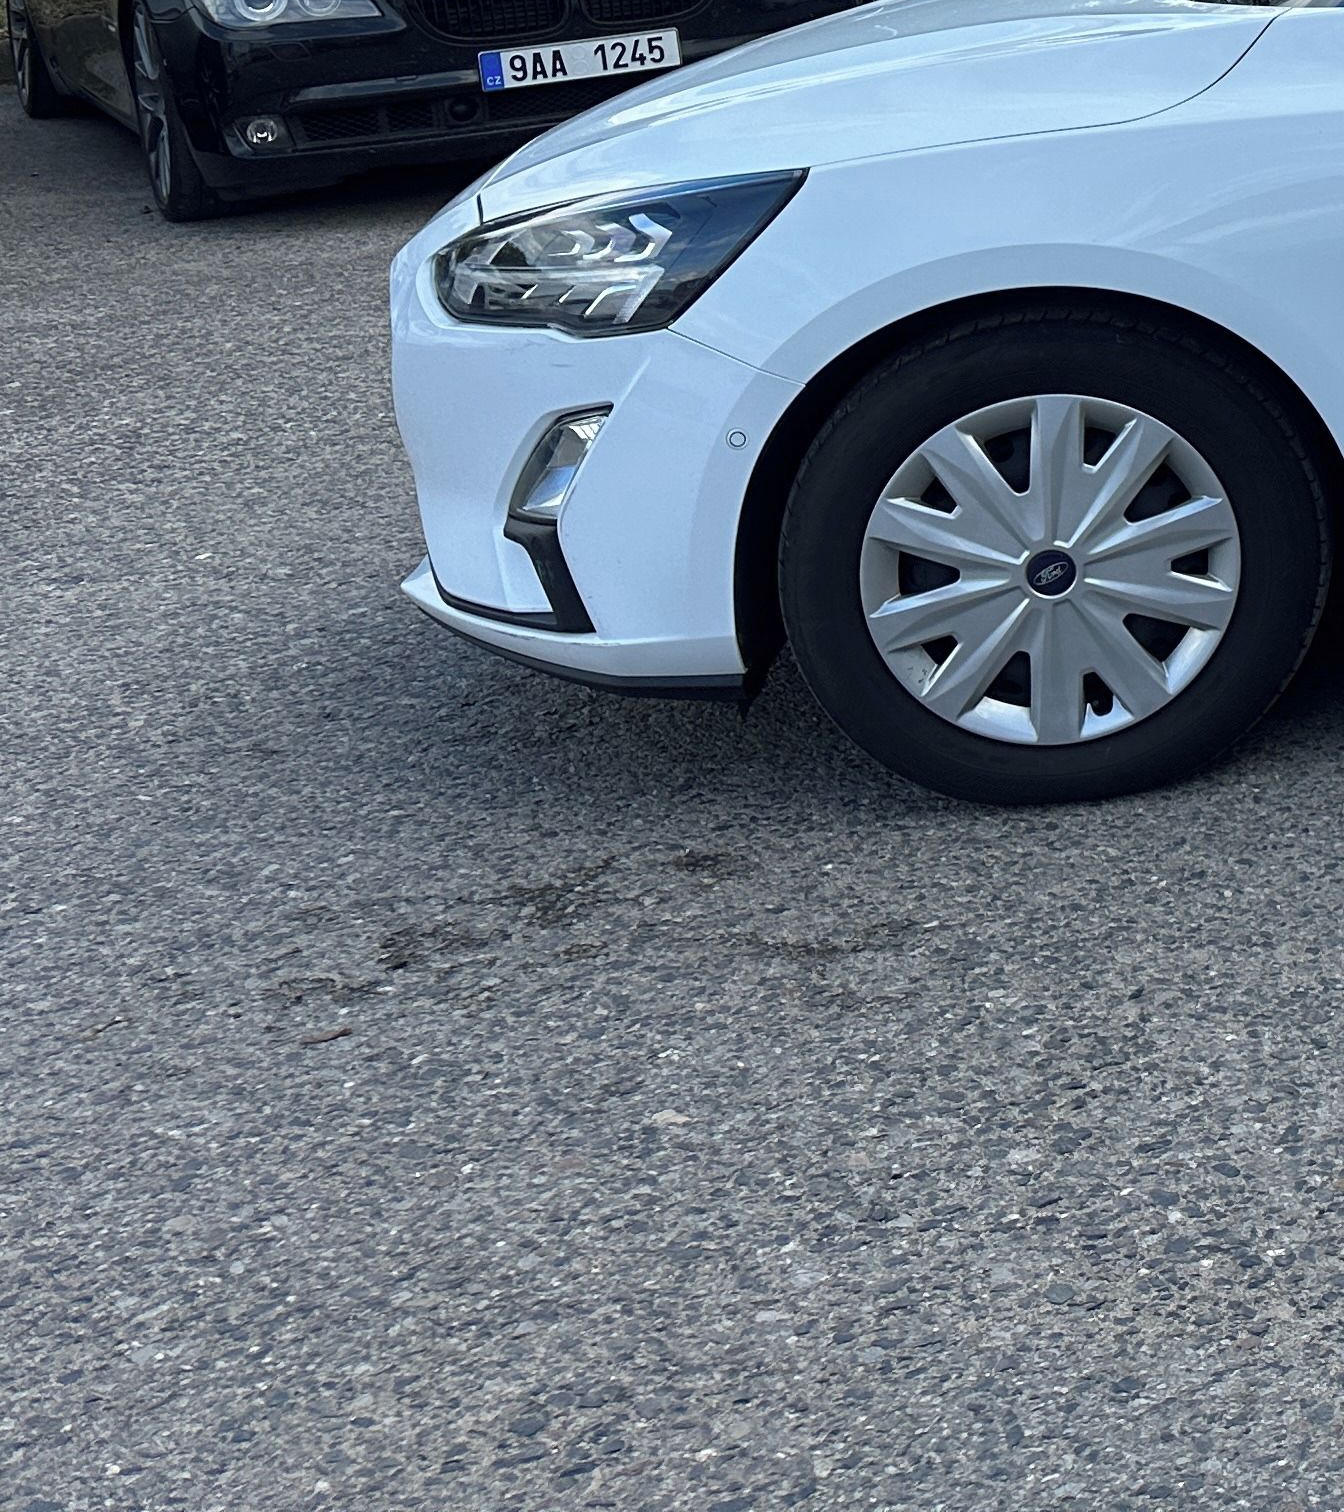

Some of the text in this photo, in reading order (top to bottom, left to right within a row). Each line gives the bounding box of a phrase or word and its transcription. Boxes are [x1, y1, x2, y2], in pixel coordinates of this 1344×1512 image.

[508, 36, 665, 82] 9AA 1245
[486, 75, 502, 86] CZ
